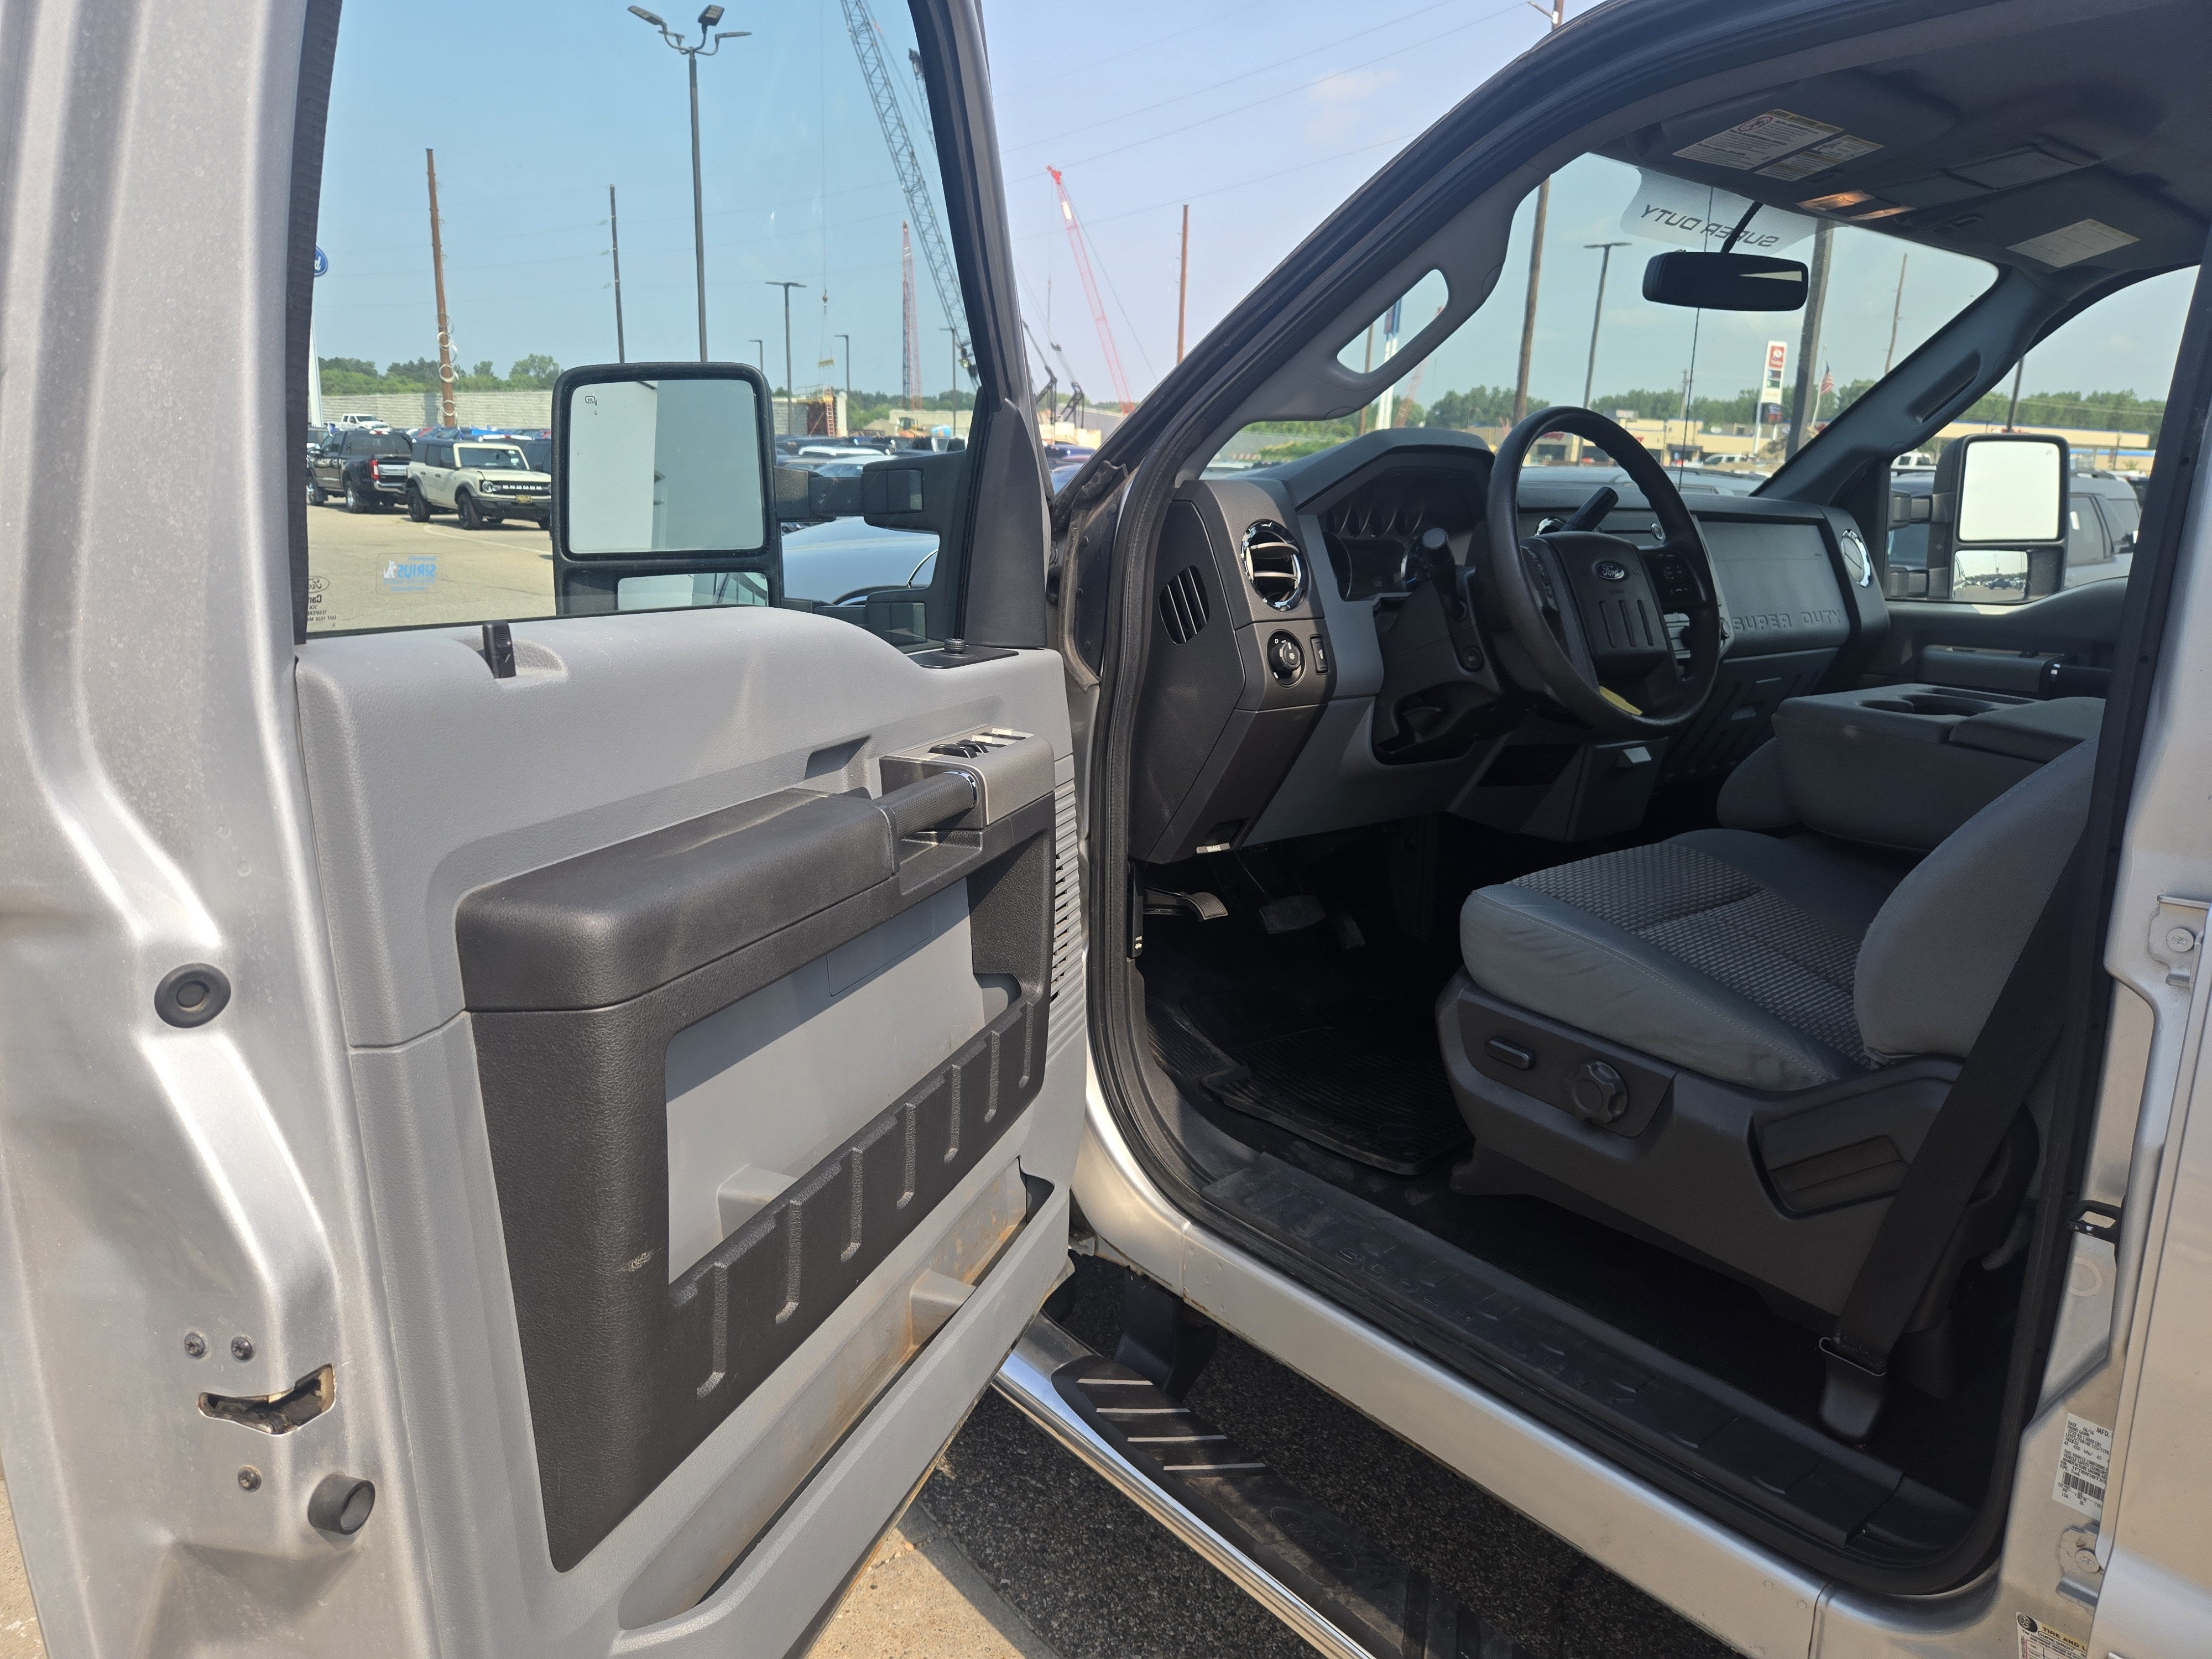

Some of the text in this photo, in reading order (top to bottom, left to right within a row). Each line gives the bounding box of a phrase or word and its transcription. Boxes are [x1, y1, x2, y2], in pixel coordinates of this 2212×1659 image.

[1602, 565, 1619, 576] Ford
[1732, 610, 1841, 632] SUPER DUTY
[1206, 844, 1222, 853] BRAKE
[2042, 1626, 2060, 1639] TIRE
[2063, 1637, 2079, 1647] AND
